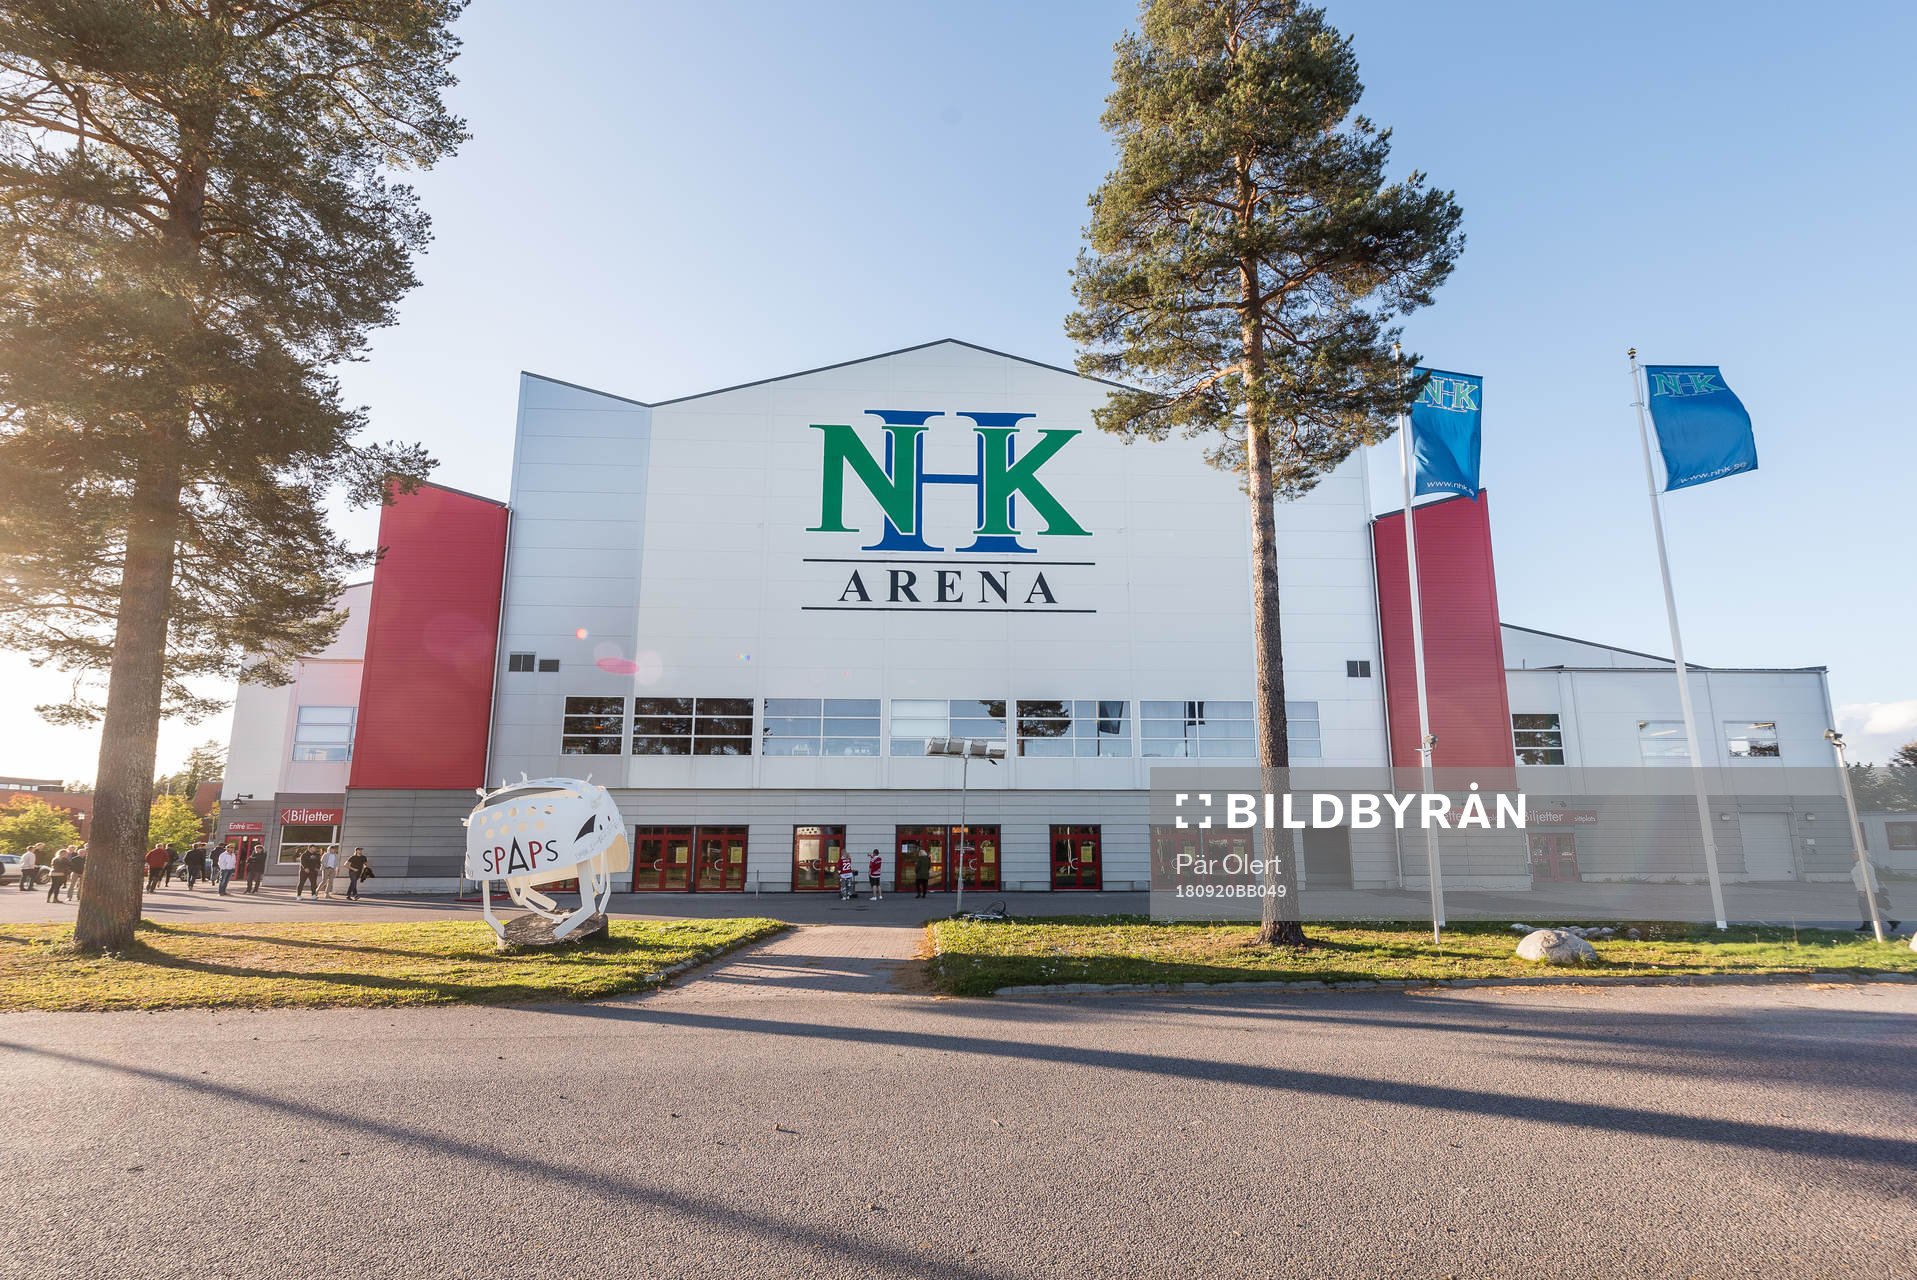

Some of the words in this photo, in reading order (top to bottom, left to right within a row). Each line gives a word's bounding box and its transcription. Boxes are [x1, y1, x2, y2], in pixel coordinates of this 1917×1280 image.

[1414, 376, 1479, 412] NHK
[1651, 371, 1727, 398] NHK
[805, 409, 1093, 553] NHK
[837, 568, 1059, 605] ARENA
[229, 822, 246, 830] Entré
[290, 808, 335, 824] Biljetter
[482, 835, 559, 875] SPAPS
[842, 862, 851, 871] 22
